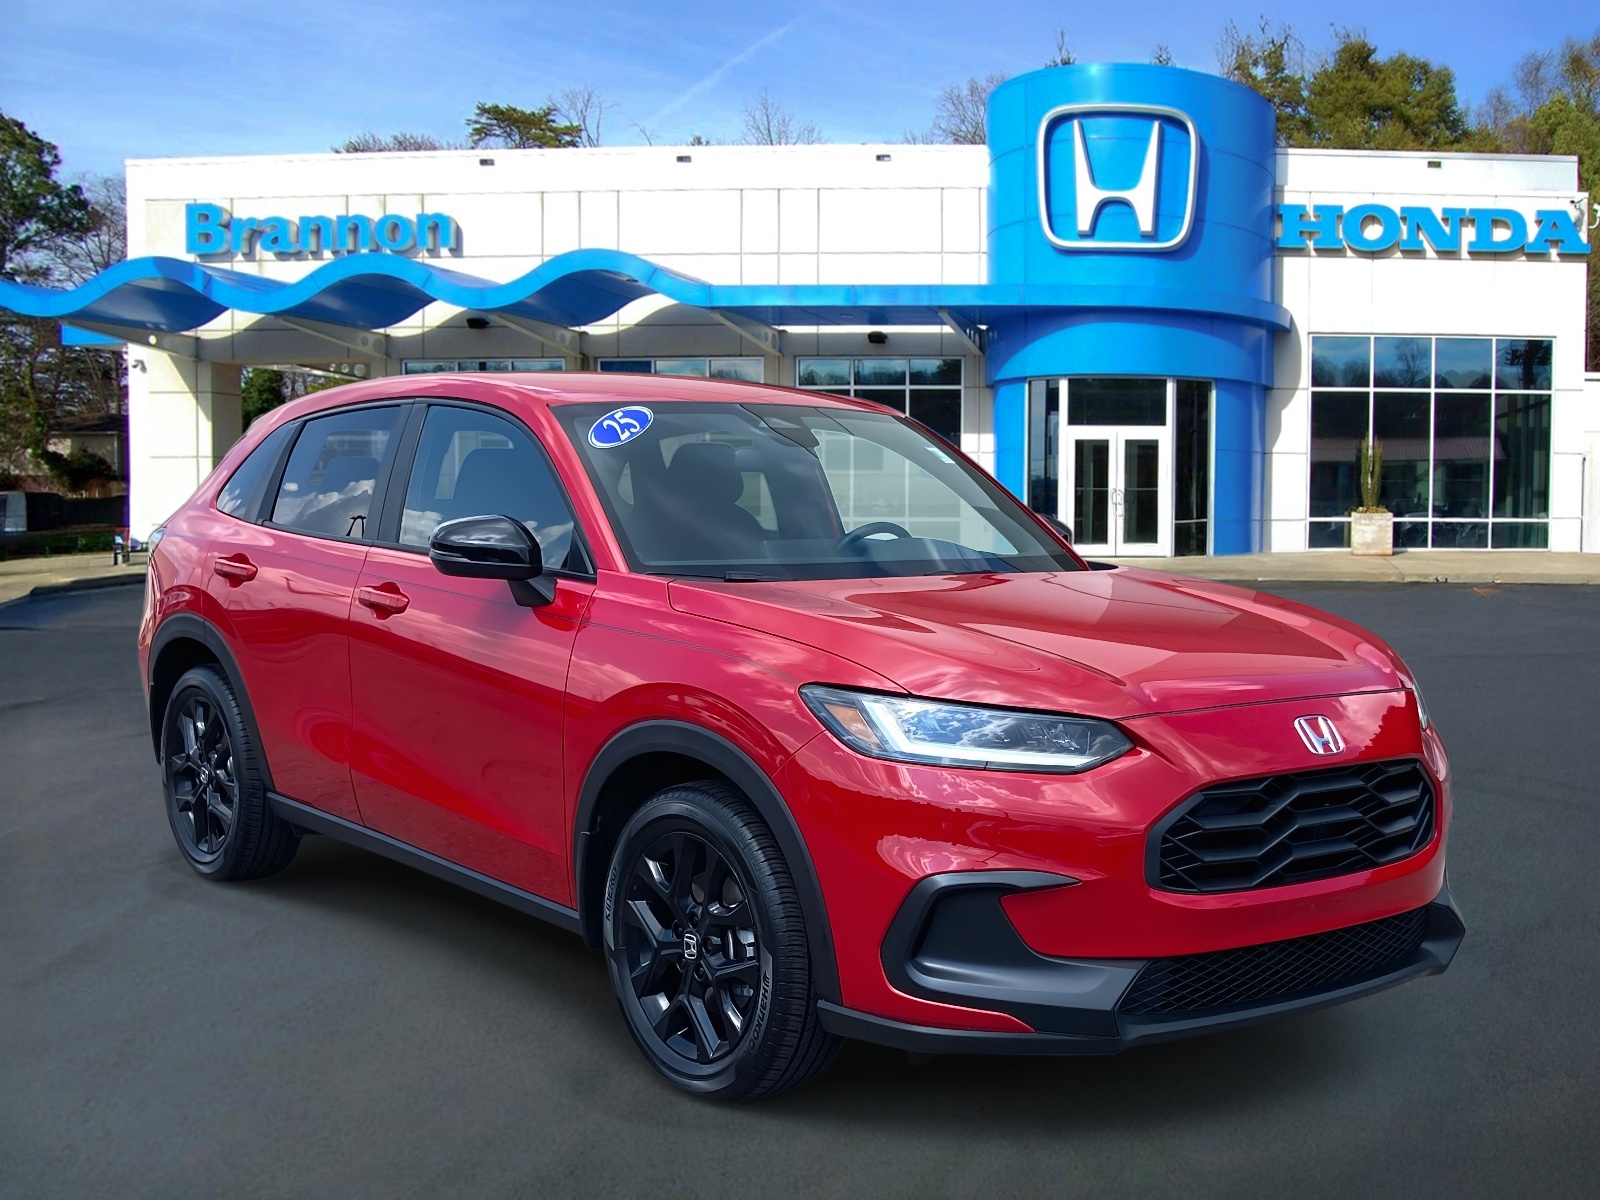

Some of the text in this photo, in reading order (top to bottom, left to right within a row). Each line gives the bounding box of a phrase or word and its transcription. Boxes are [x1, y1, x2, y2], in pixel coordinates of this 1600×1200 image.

[185, 202, 453, 255] Brannon
[1276, 203, 1592, 254] HONDA
[602, 411, 641, 441] 25
